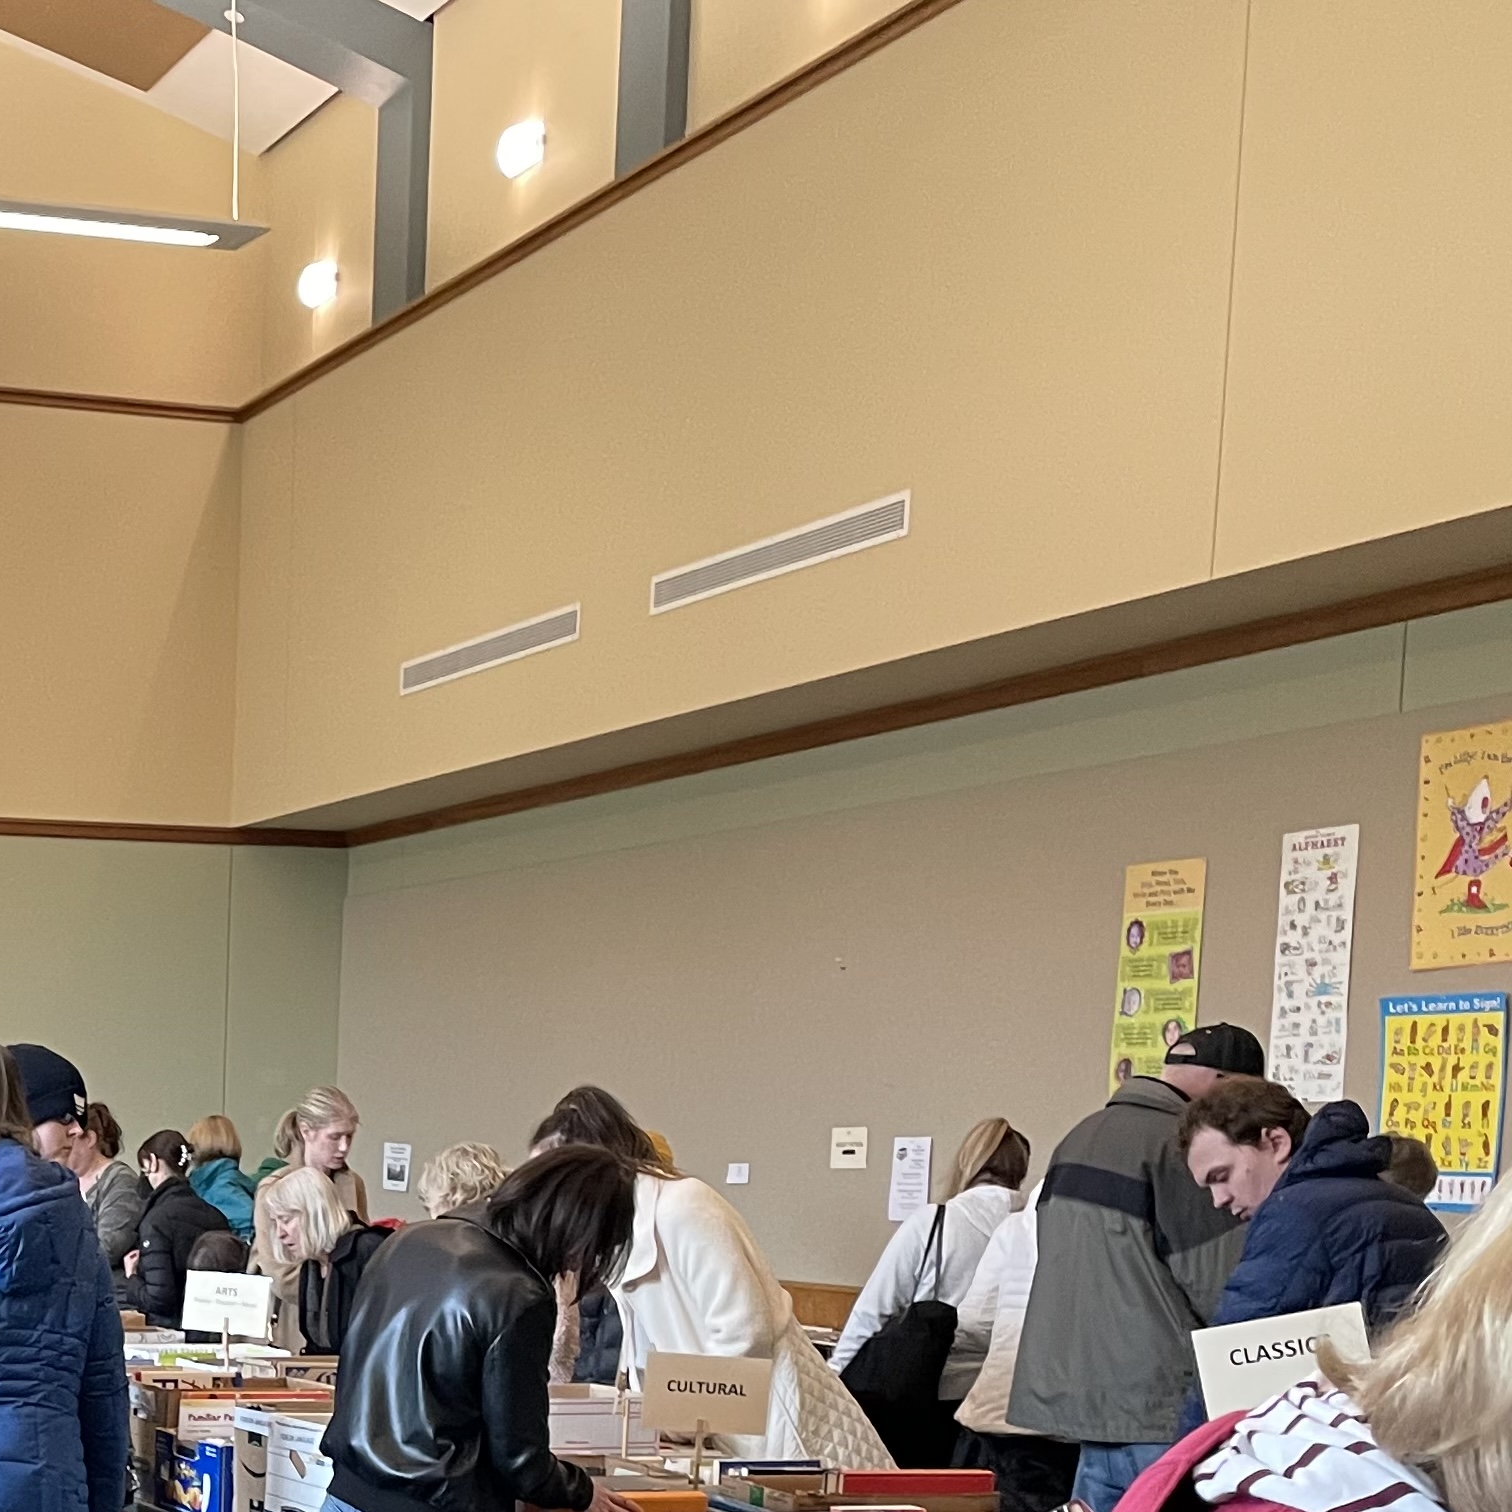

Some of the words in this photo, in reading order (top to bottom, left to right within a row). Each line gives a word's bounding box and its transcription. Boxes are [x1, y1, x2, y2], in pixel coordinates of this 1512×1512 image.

[1291, 837, 1346, 852] ALPHABET
[1389, 1002, 1418, 1014] Let's
[1421, 1000, 1456, 1012] Learn
[1459, 999, 1470, 1009] to
[1473, 996, 1501, 1012] Sign!
[216, 1287, 238, 1297] ARTS
[667, 1379, 747, 1397] CULTURAL
